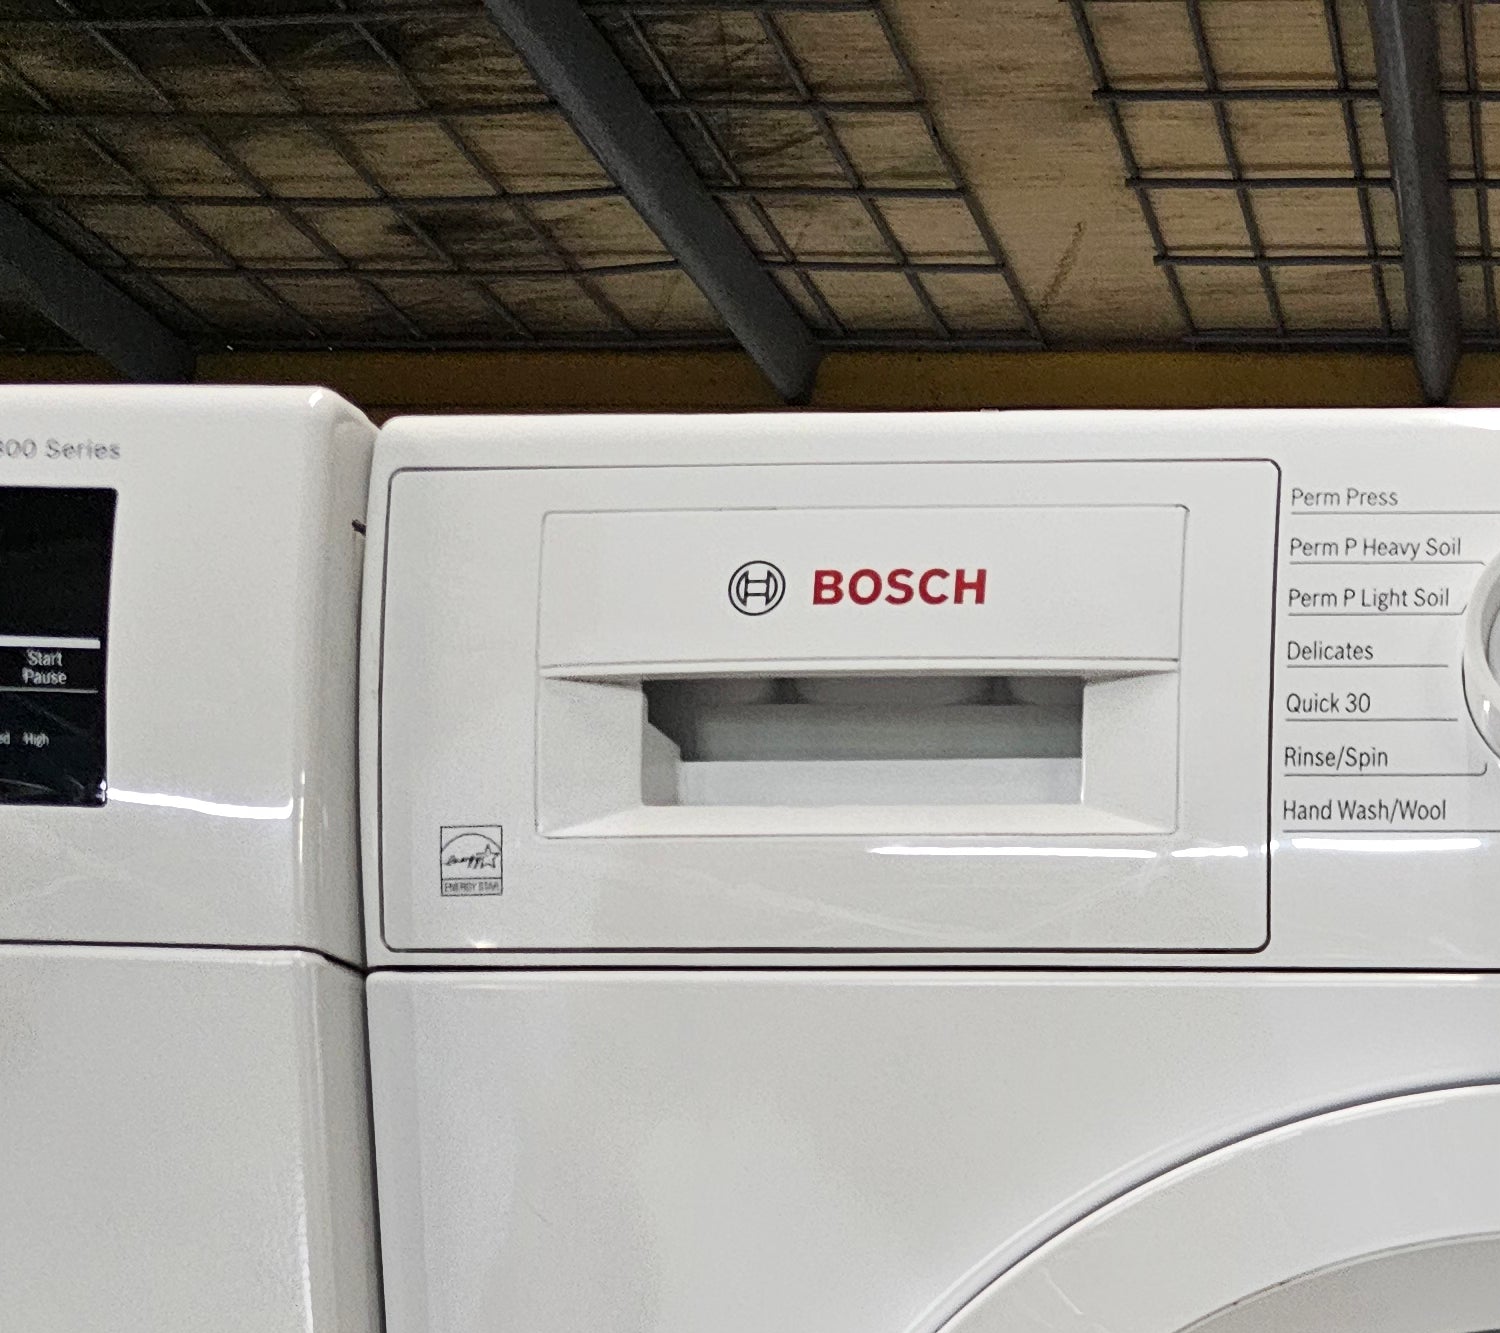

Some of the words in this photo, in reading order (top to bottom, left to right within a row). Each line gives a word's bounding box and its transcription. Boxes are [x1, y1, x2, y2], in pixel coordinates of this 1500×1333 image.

[46, 438, 120, 460] Series
[1291, 487, 1340, 506] Perm
[1346, 487, 1399, 506] Press
[1289, 537, 1339, 556] Perm
[1344, 537, 1357, 556] P
[1363, 537, 1421, 561] Heavy
[1425, 537, 1462, 556] Soil
[812, 568, 987, 605] BOSCH
[1288, 588, 1338, 608] Perm
[1343, 588, 1356, 608] P
[1361, 588, 1408, 612] Light
[1413, 588, 1450, 608] Soil
[26, 649, 63, 667] Start
[1287, 640, 1374, 661] Delicates
[22, 667, 68, 685] Pause
[1286, 694, 1339, 715] Quick
[1345, 694, 1371, 714] 30
[22, 731, 50, 748] High
[1284, 747, 1389, 770] Rinse/Spin
[1283, 800, 1332, 821] Hand
[1338, 798, 1447, 823] Wash/Wool
